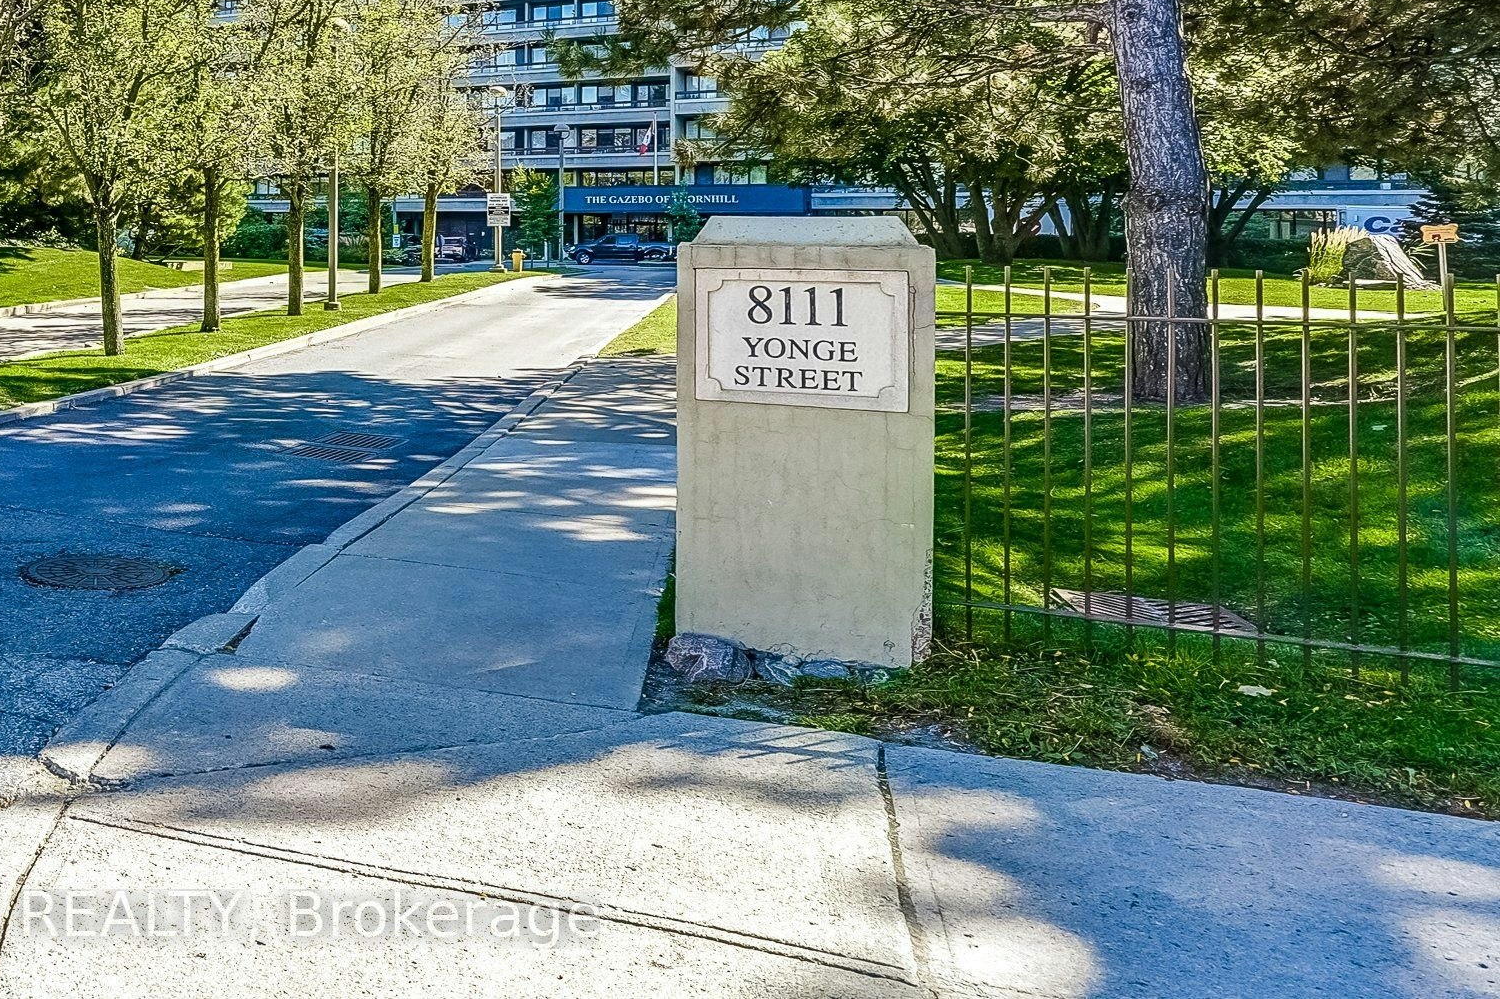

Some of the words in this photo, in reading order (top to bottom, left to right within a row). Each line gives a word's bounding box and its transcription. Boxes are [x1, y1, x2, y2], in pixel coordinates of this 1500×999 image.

[585, 195, 607, 204] THE
[608, 195, 653, 204] GAZEBO
[655, 195, 671, 204] OF
[672, 195, 739, 204] ORNHILL
[747, 285, 848, 327] 8111
[742, 336, 859, 363] YONGE
[734, 365, 863, 392] STREET
